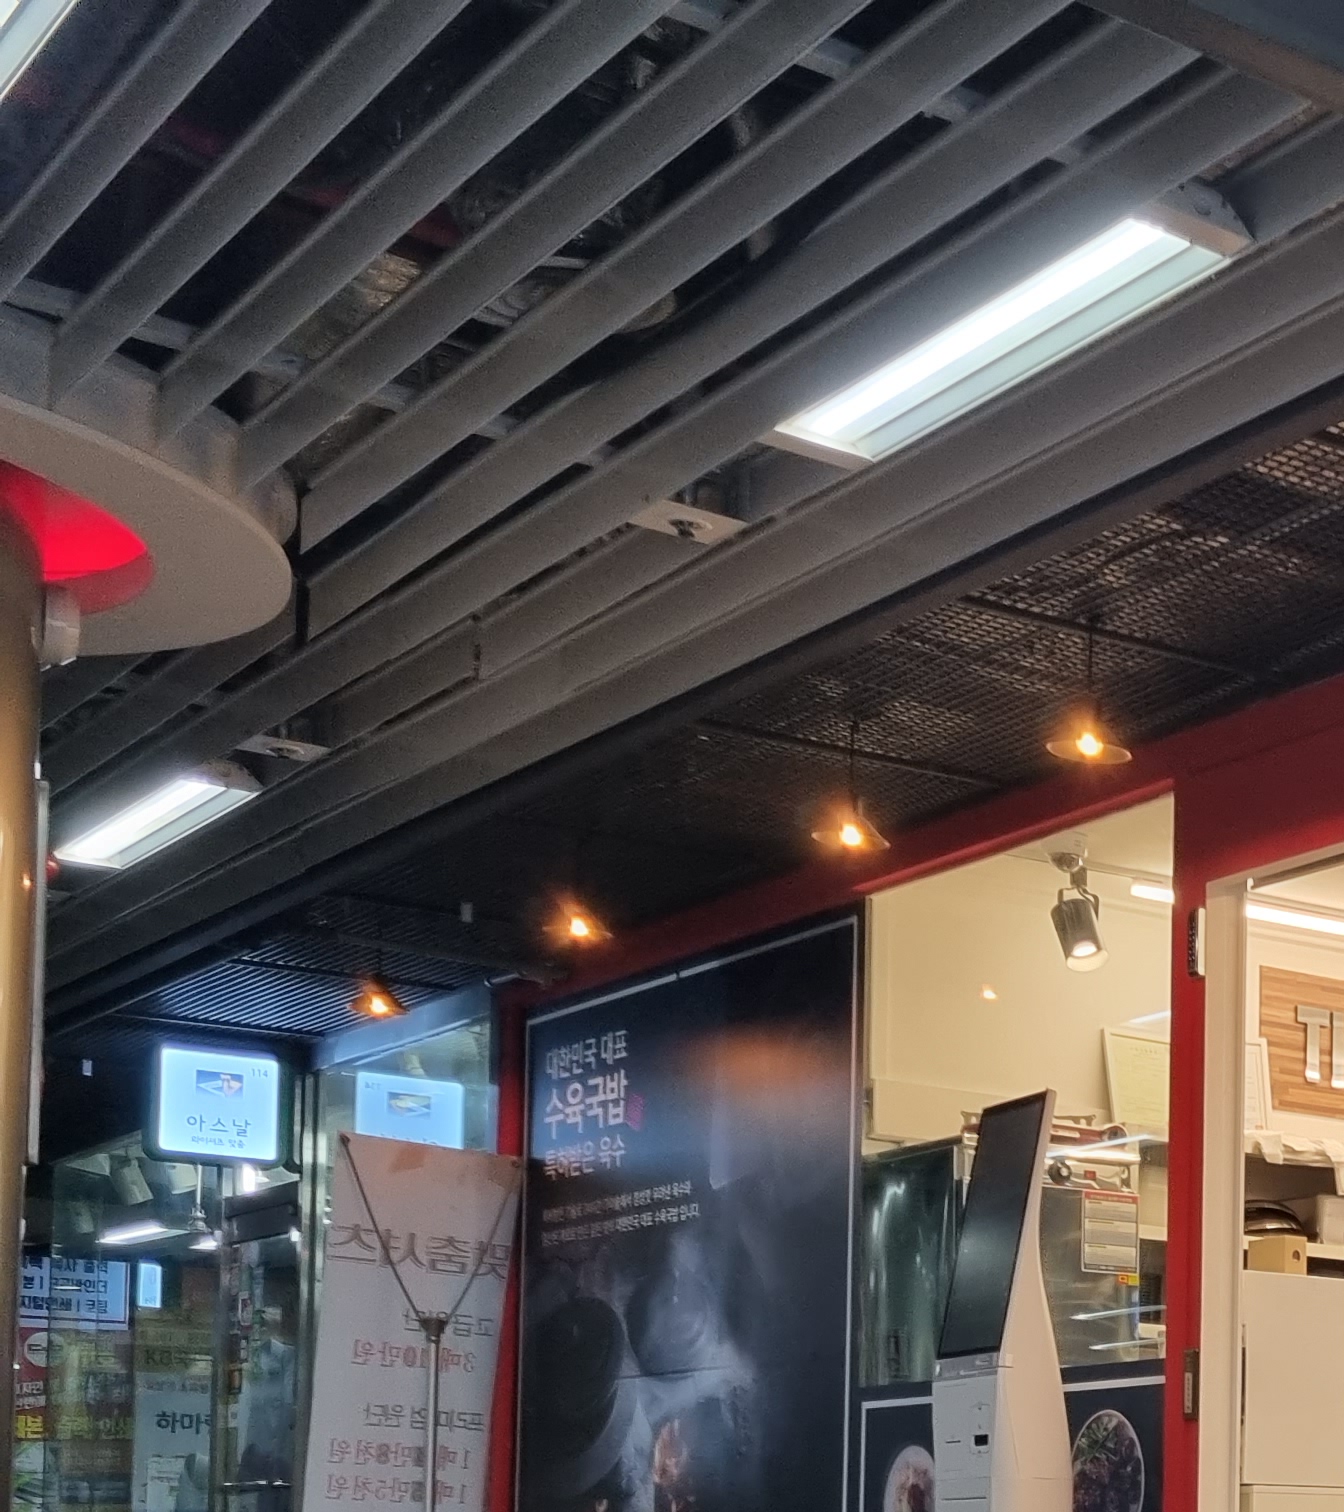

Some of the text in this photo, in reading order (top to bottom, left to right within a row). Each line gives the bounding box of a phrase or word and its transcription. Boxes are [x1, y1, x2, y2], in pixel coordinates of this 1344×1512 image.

[546, 1029, 629, 1079] 대한민국 대표
[251, 1068, 268, 1079] 114
[544, 1068, 629, 1140] 수육국밥
[187, 1115, 252, 1138] 아스날
[228, 1138, 246, 1149] 맞춤
[599, 1133, 627, 1169] 육수
